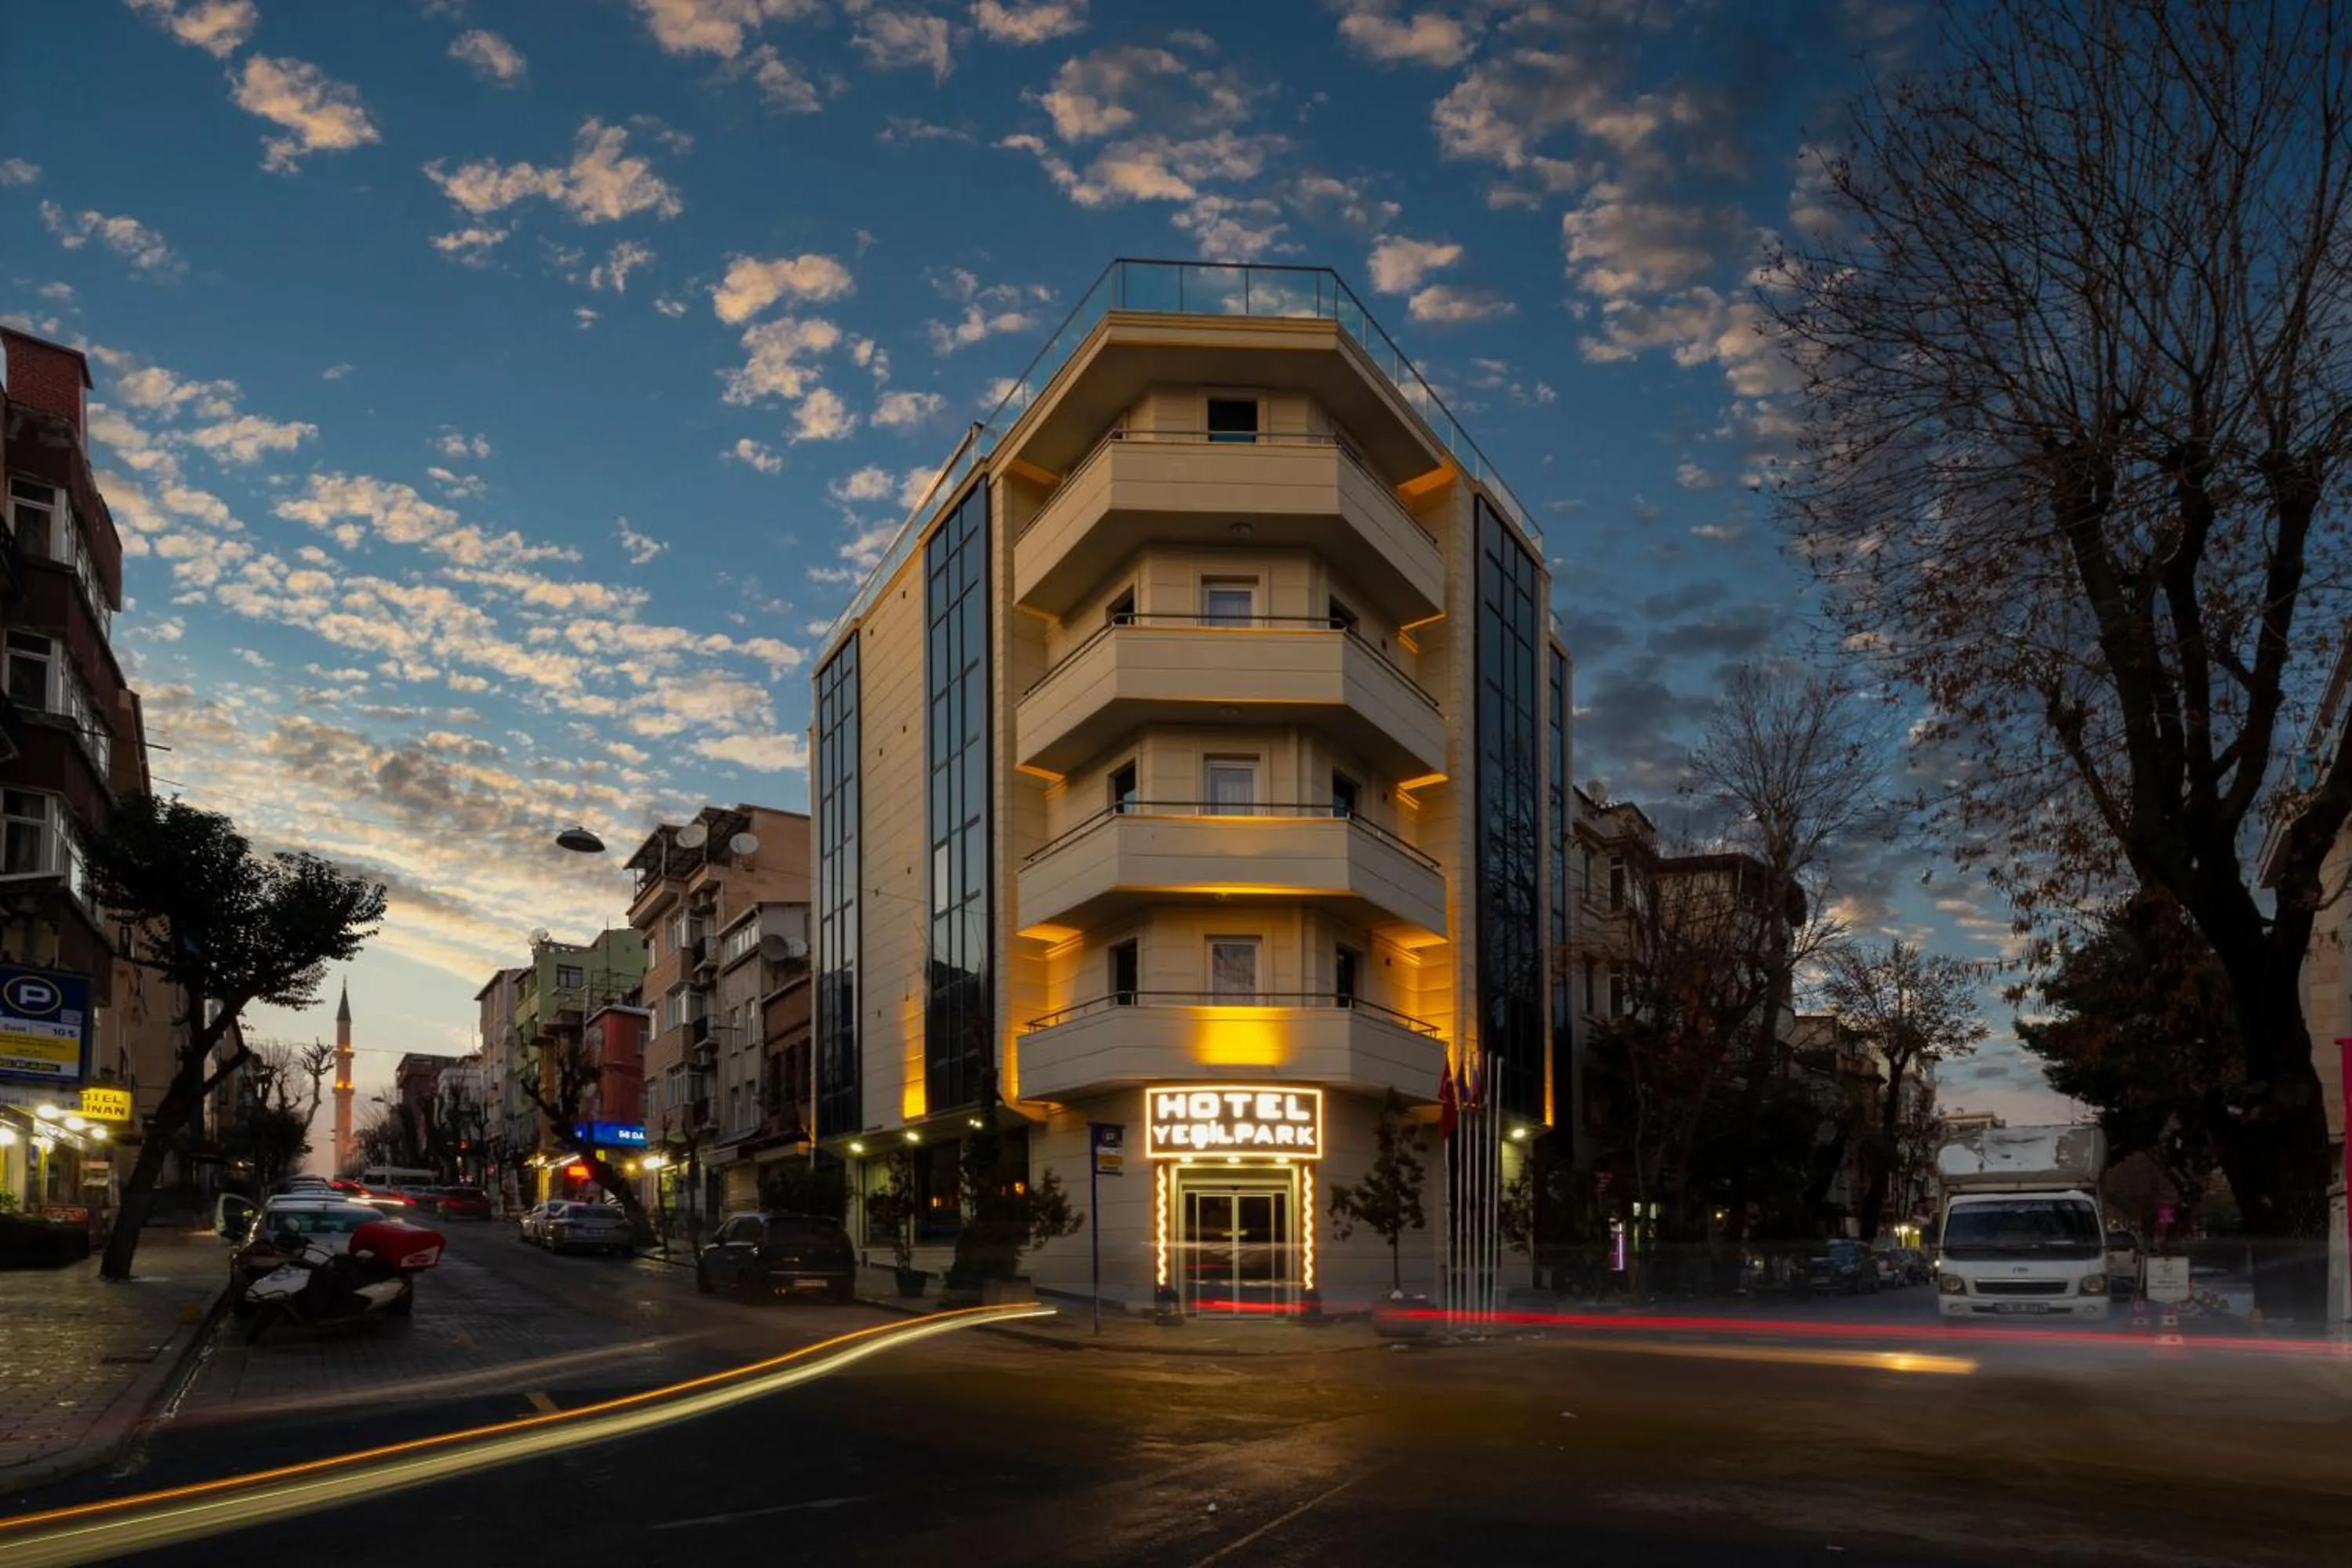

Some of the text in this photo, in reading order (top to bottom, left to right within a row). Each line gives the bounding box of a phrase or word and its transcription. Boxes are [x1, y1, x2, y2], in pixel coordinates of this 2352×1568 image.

[19, 985, 52, 1004] P
[1157, 1093, 1310, 1120] HOTEL
[1152, 1120, 1316, 1149] YEŞİLPARK
